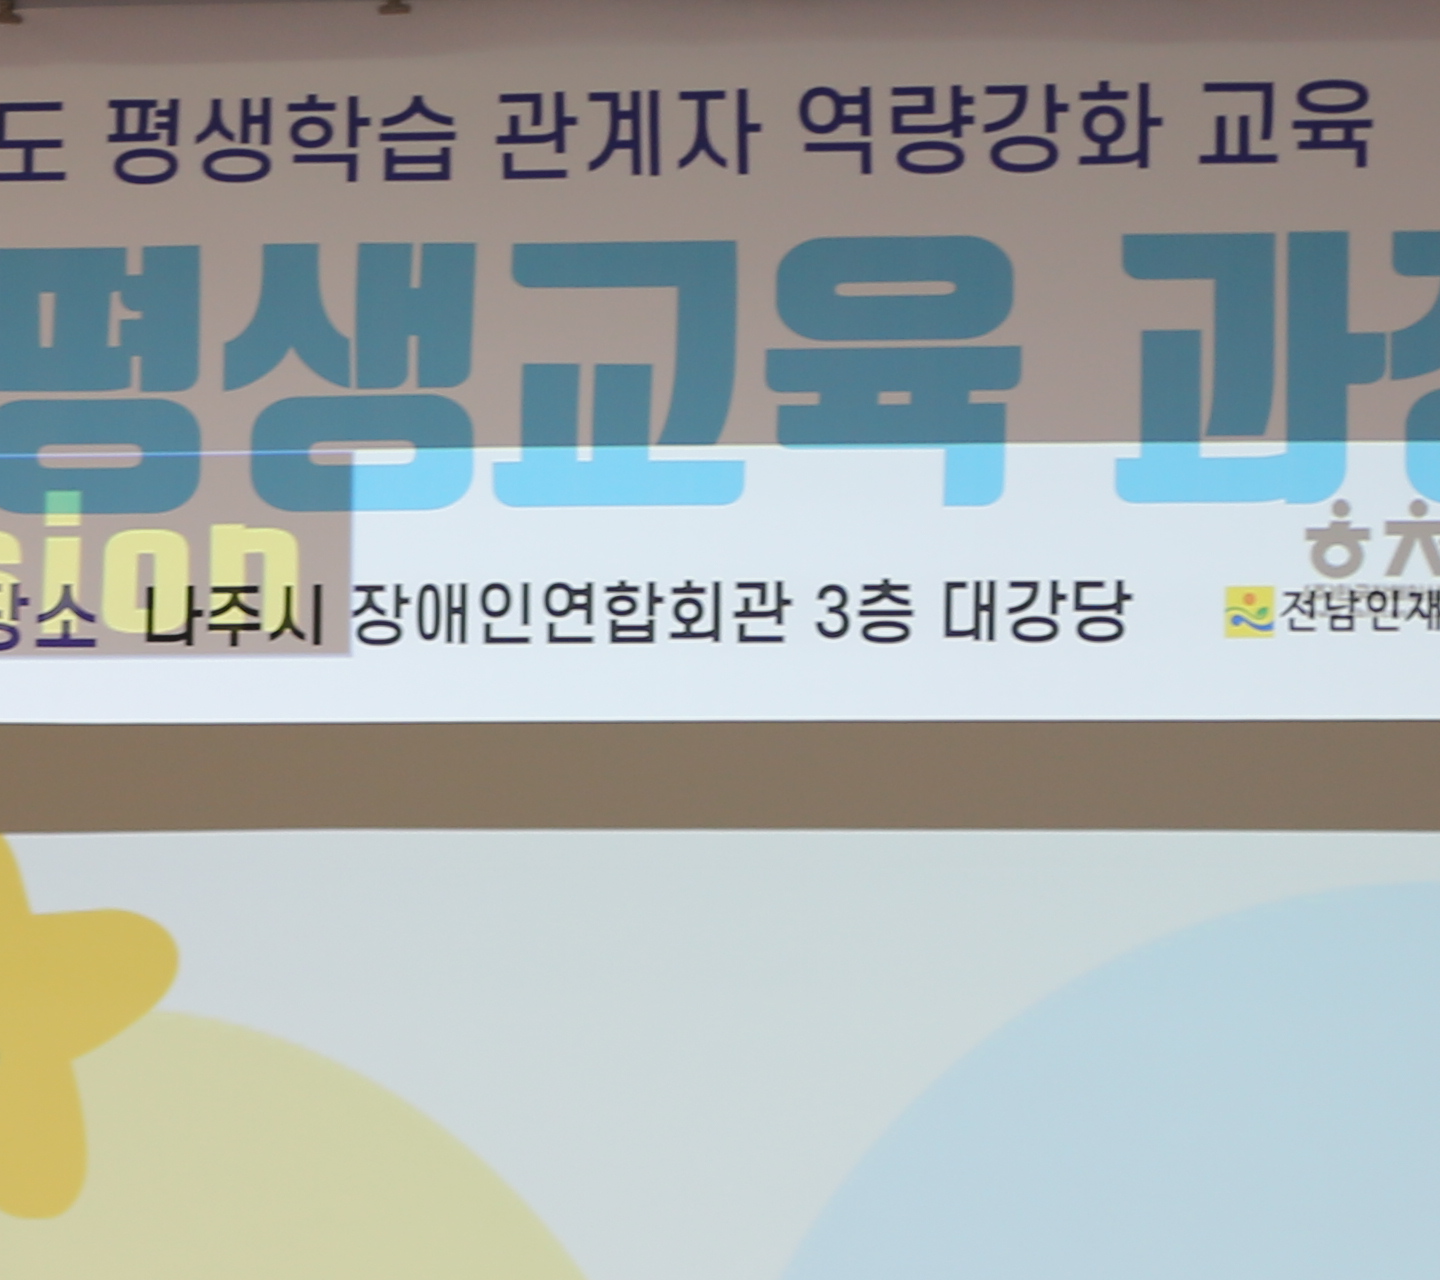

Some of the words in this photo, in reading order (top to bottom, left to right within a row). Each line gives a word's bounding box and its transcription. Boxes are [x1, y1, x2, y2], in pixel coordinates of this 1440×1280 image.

[107, 93, 458, 185] 평생학습
[495, 86, 763, 181] 관계자
[796, 79, 1164, 176] 역량강화
[1197, 77, 1374, 168] 교육
[144, 582, 324, 648] 나주시
[352, 579, 795, 646] 장애인연합회관
[814, 577, 916, 645] 3층
[941, 578, 1134, 645] 대강당
